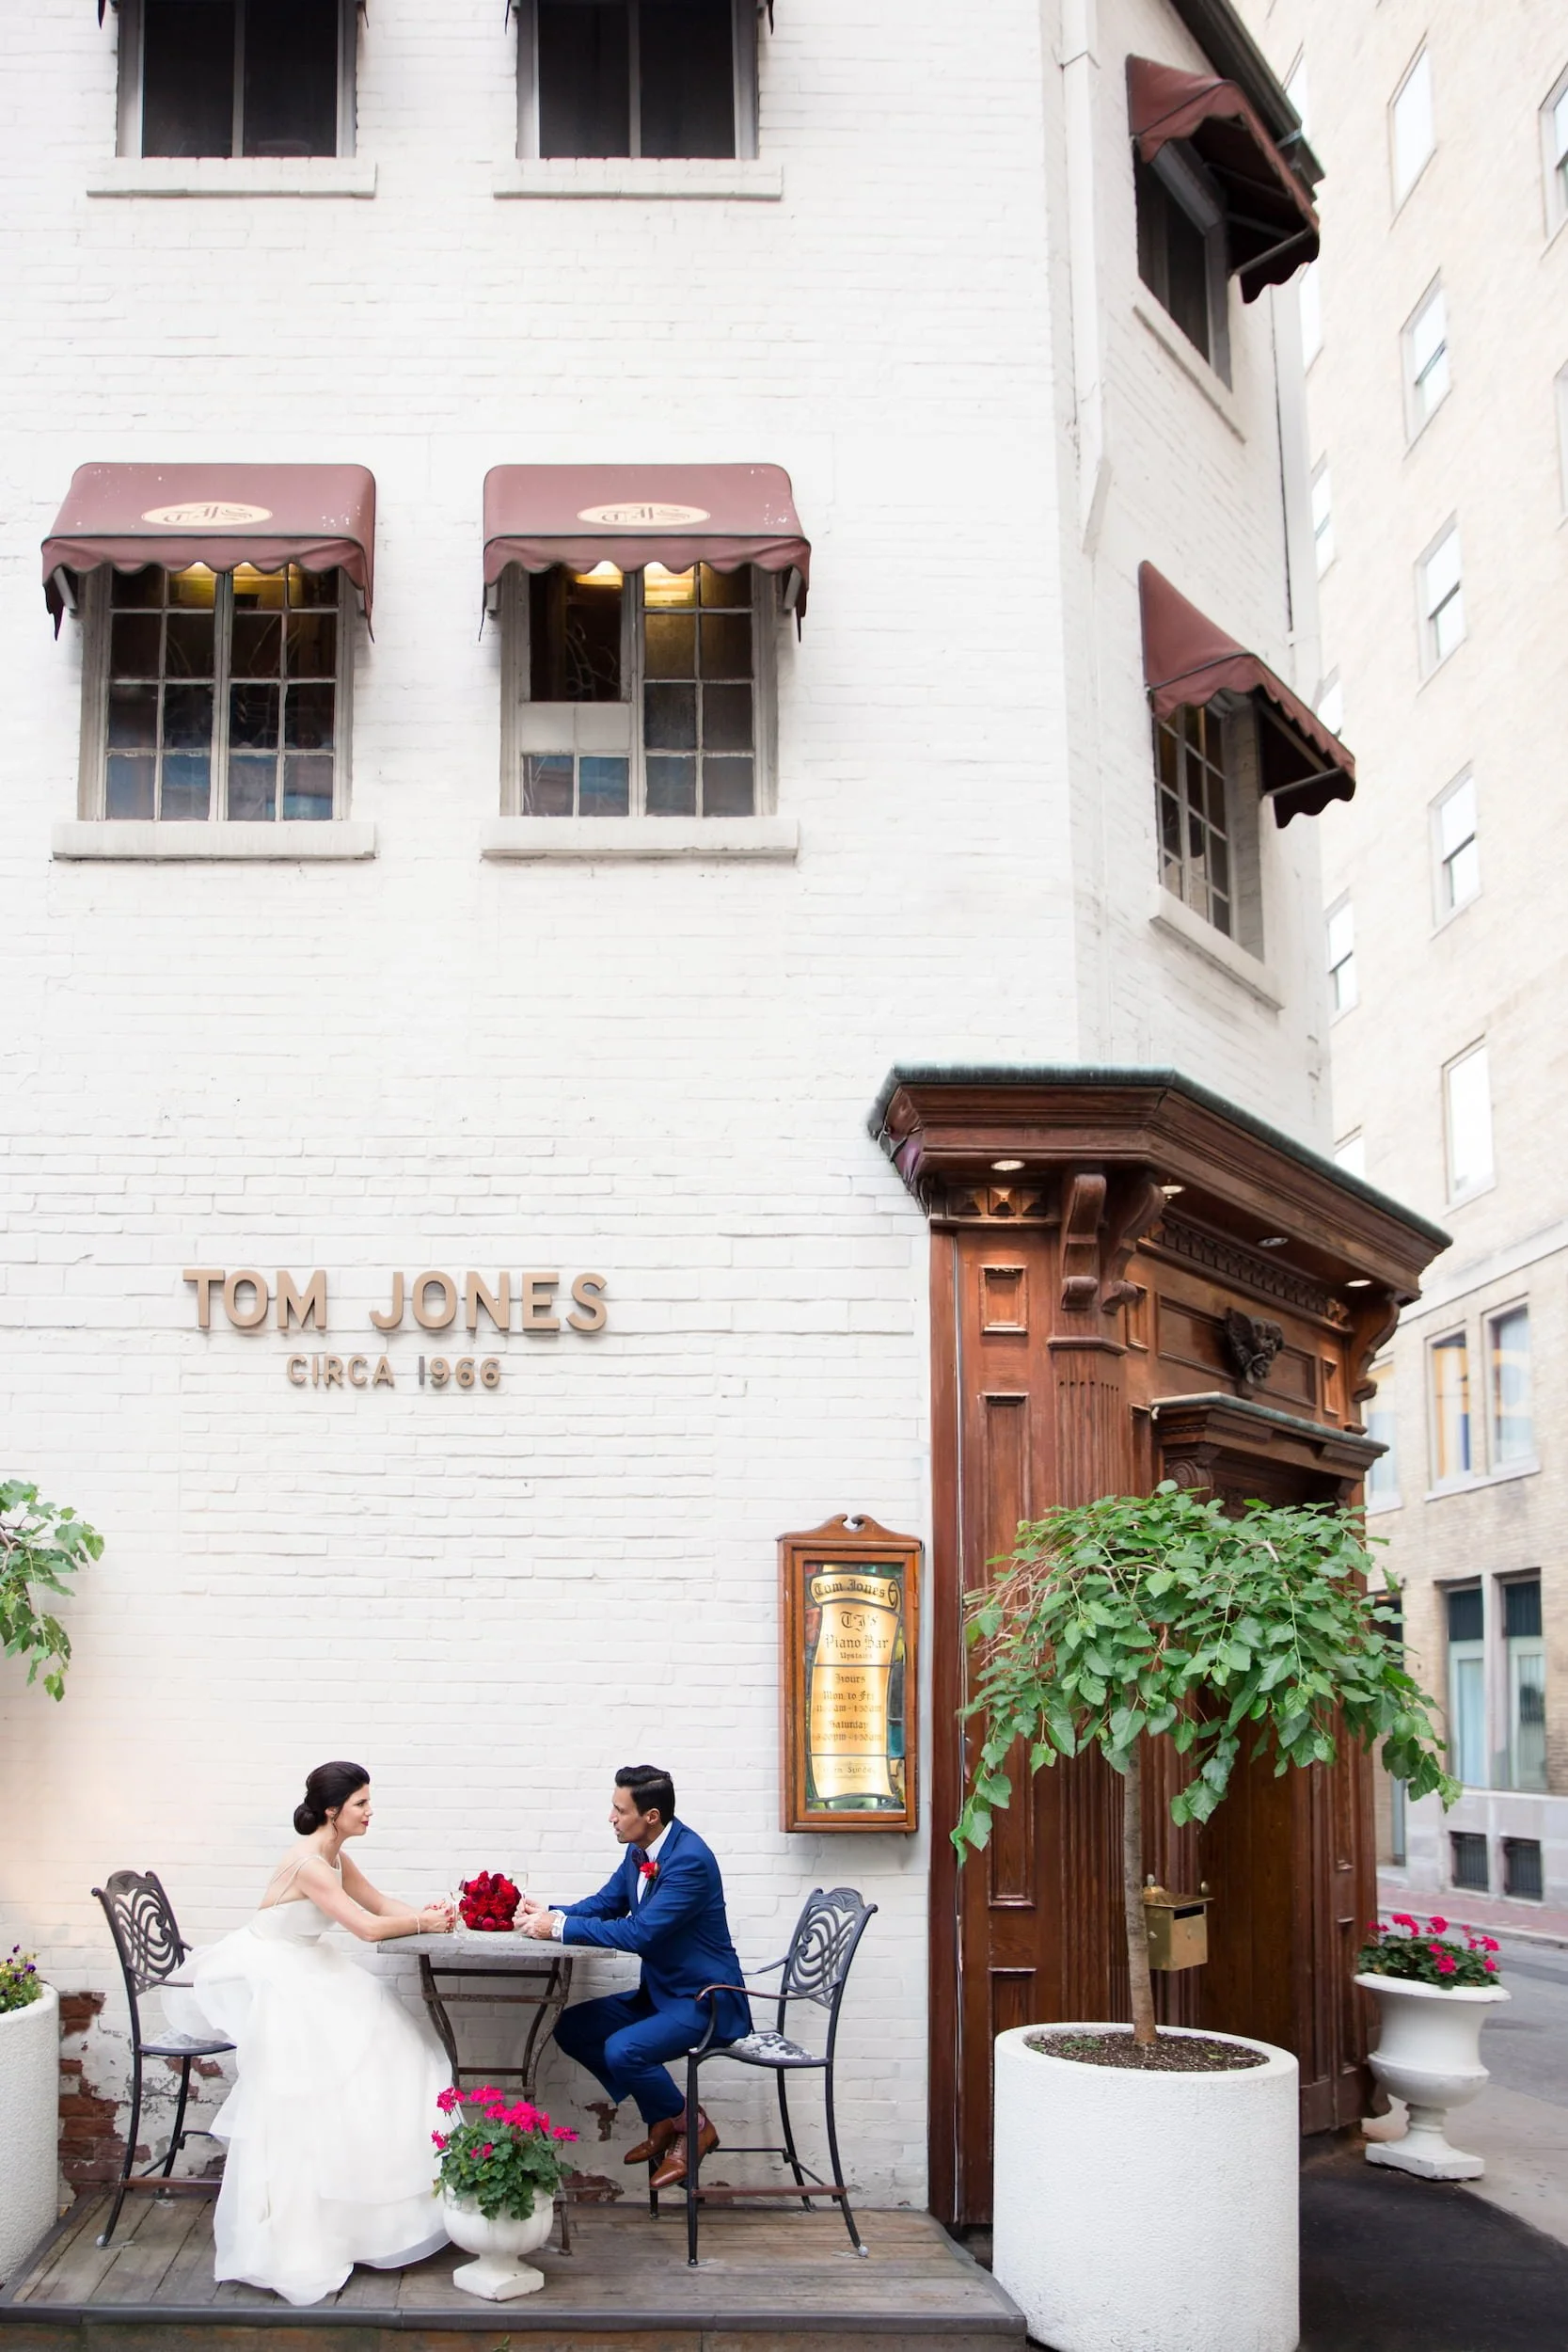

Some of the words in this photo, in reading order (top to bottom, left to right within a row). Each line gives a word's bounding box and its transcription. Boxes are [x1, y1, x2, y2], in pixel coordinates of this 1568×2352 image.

[182, 1269, 327, 1329] TOM
[369, 1270, 608, 1332] JONES
[286, 1355, 395, 1387] CIRCA
[419, 1355, 501, 1388] 1966
[814, 1582, 844, 1597] Tom
[847, 1579, 885, 1598] Jones
[825, 1634, 861, 1649] Piano
[863, 1634, 889, 1650] Bar
